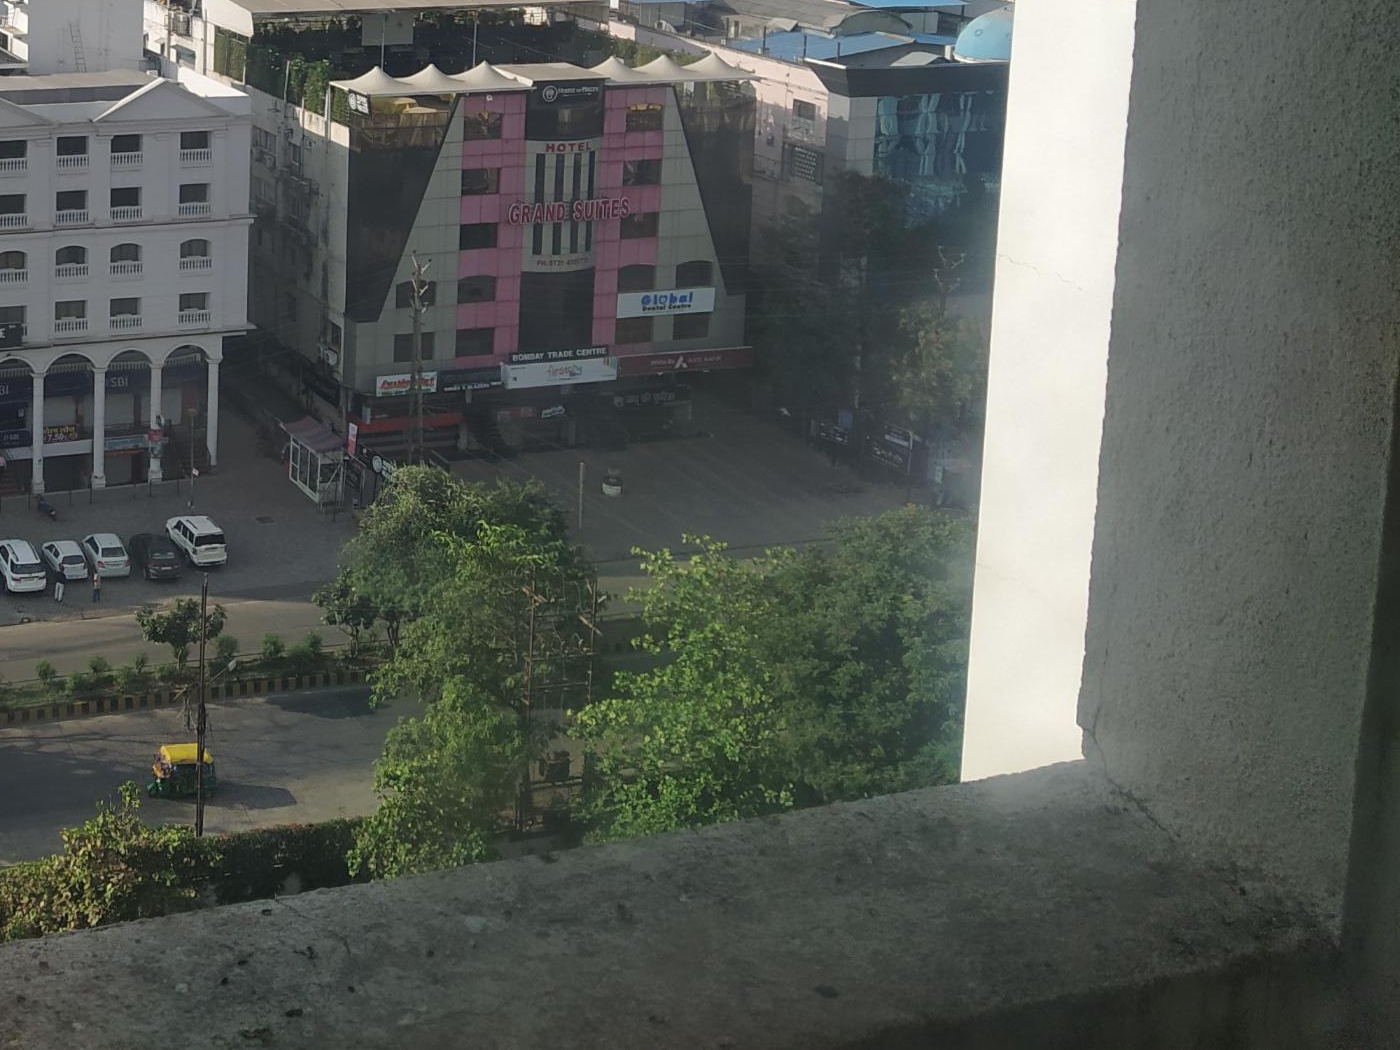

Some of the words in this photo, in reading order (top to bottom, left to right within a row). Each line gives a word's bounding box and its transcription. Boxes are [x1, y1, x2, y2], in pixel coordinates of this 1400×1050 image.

[546, 141, 592, 152] HOTEL
[508, 202, 566, 225] GRAND
[573, 197, 630, 222] SUITES
[641, 291, 694, 305] Global
[512, 352, 544, 362] BOMBAY
[547, 349, 574, 359] TRADE
[576, 347, 607, 357] CENTRE
[111, 376, 129, 388] SBI
